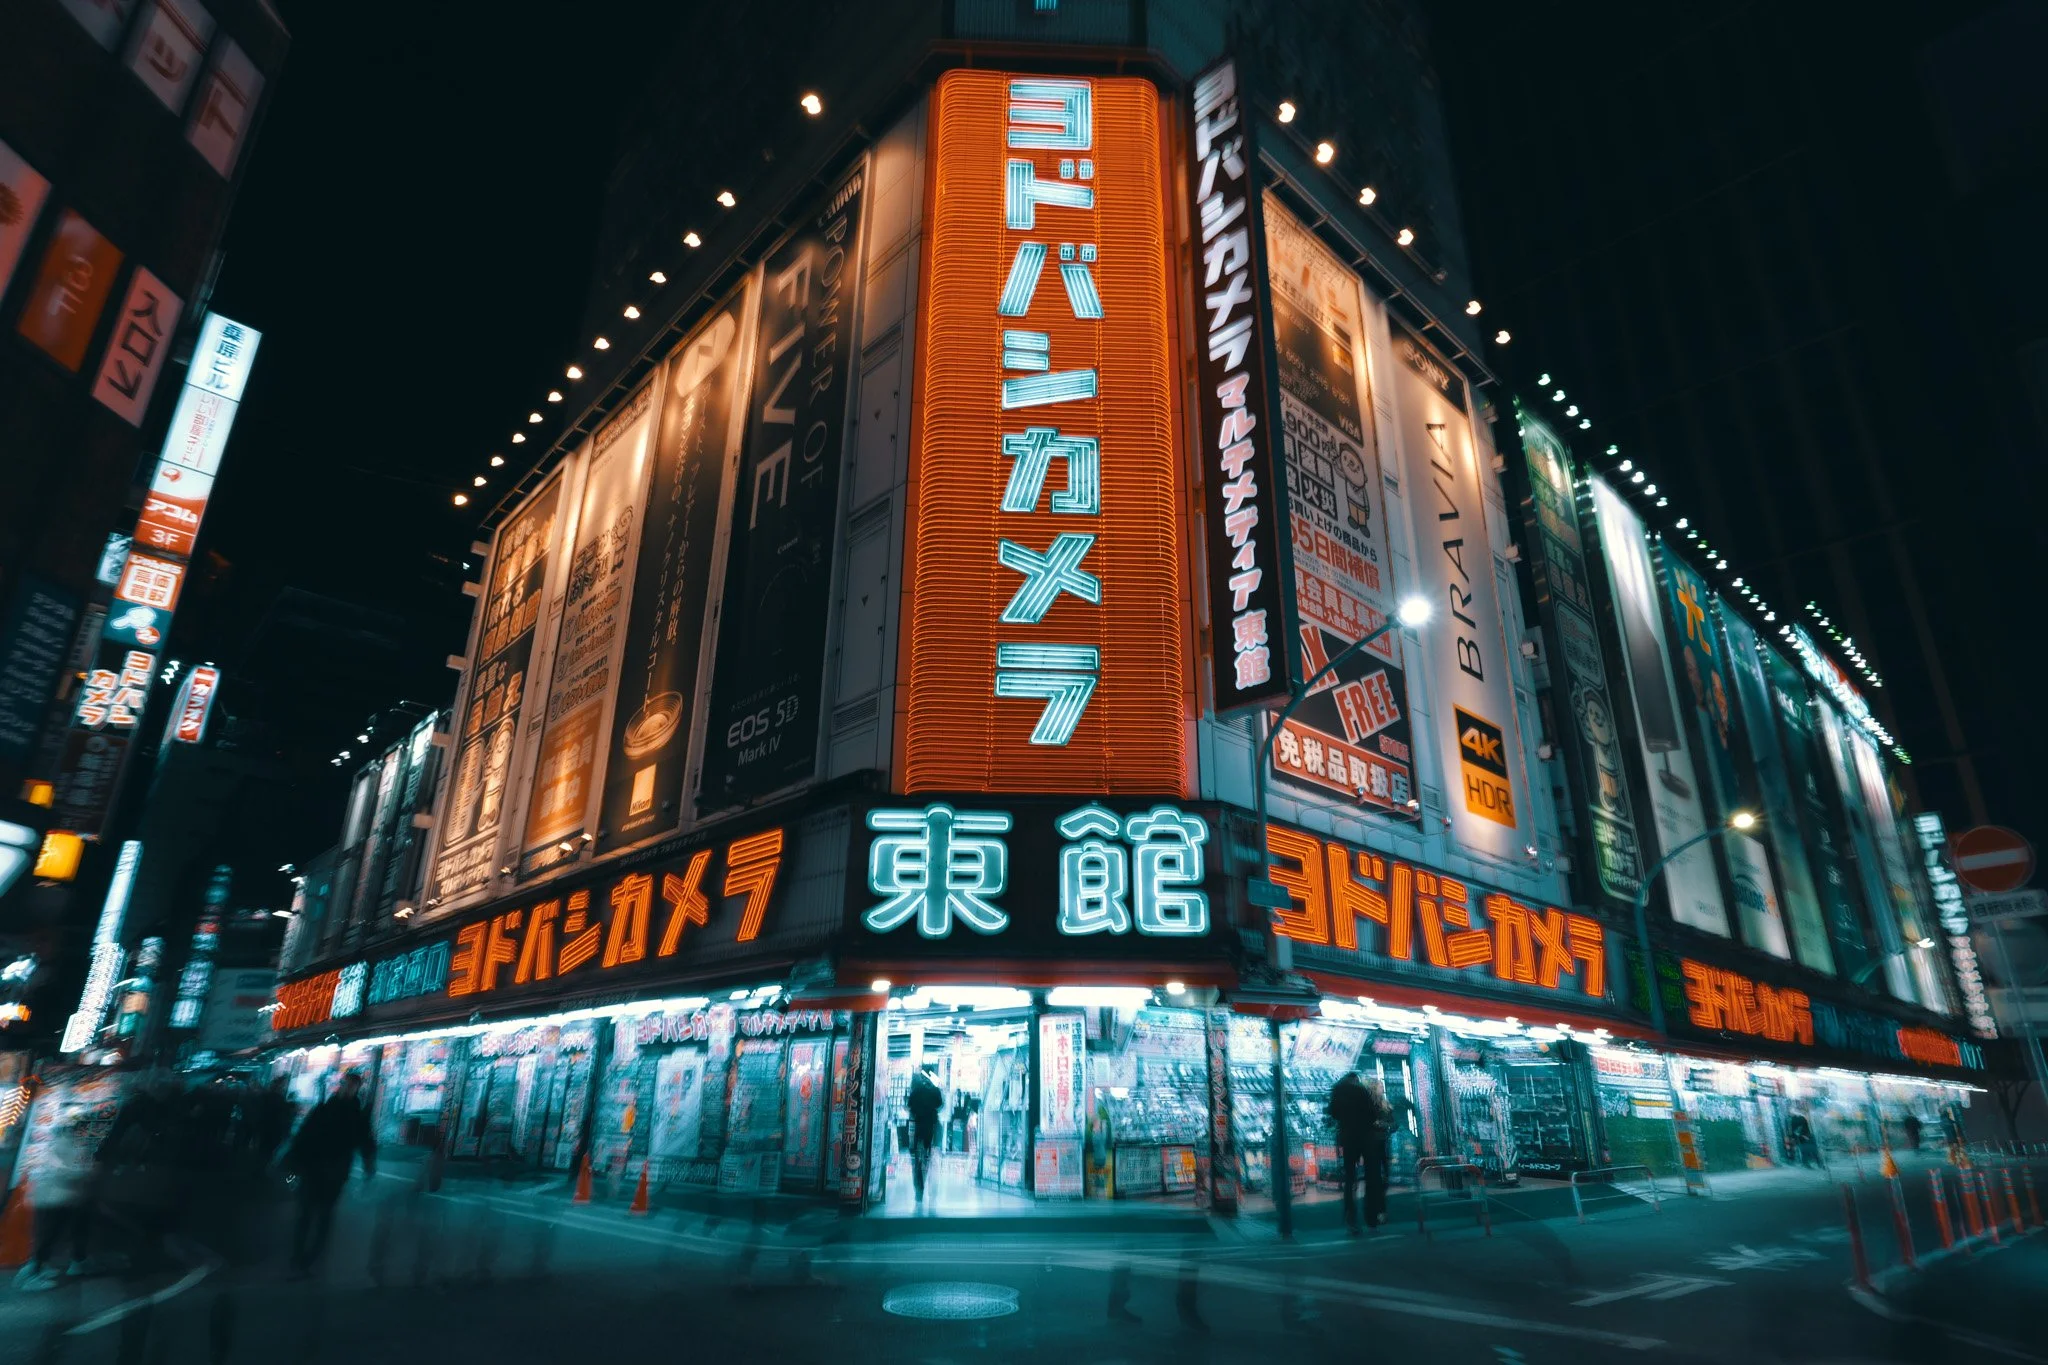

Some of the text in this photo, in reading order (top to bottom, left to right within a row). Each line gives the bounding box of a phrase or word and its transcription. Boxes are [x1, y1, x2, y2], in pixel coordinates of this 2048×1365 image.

[120, 291, 163, 368] 入口
[809, 214, 849, 404] POWER
[748, 248, 813, 530] FIVE
[1194, 57, 1271, 691] ヨドバシカメラ マルチメディア東館
[1403, 341, 1450, 391] SONY
[996, 78, 1106, 747] ヨドバシカメラ
[1338, 413, 1361, 439] VISA
[801, 420, 828, 489] OF
[1303, 477, 1335, 513] 火災
[150, 527, 180, 547] 3F
[1426, 422, 1484, 682] BRAVIA
[727, 692, 800, 750] EOS 5D
[1332, 667, 1401, 745] FREE
[737, 738, 766, 767] Mark
[763, 734, 781, 757] IV
[1279, 725, 1410, 808] 免税品取扱店
[1461, 725, 1503, 766] 4K
[1466, 772, 1513, 814] HDR
[866, 803, 1209, 938] 東館
[448, 828, 784, 998] ヨドバシカメラ
[1266, 823, 1606, 997] ヨドバシカメラ
